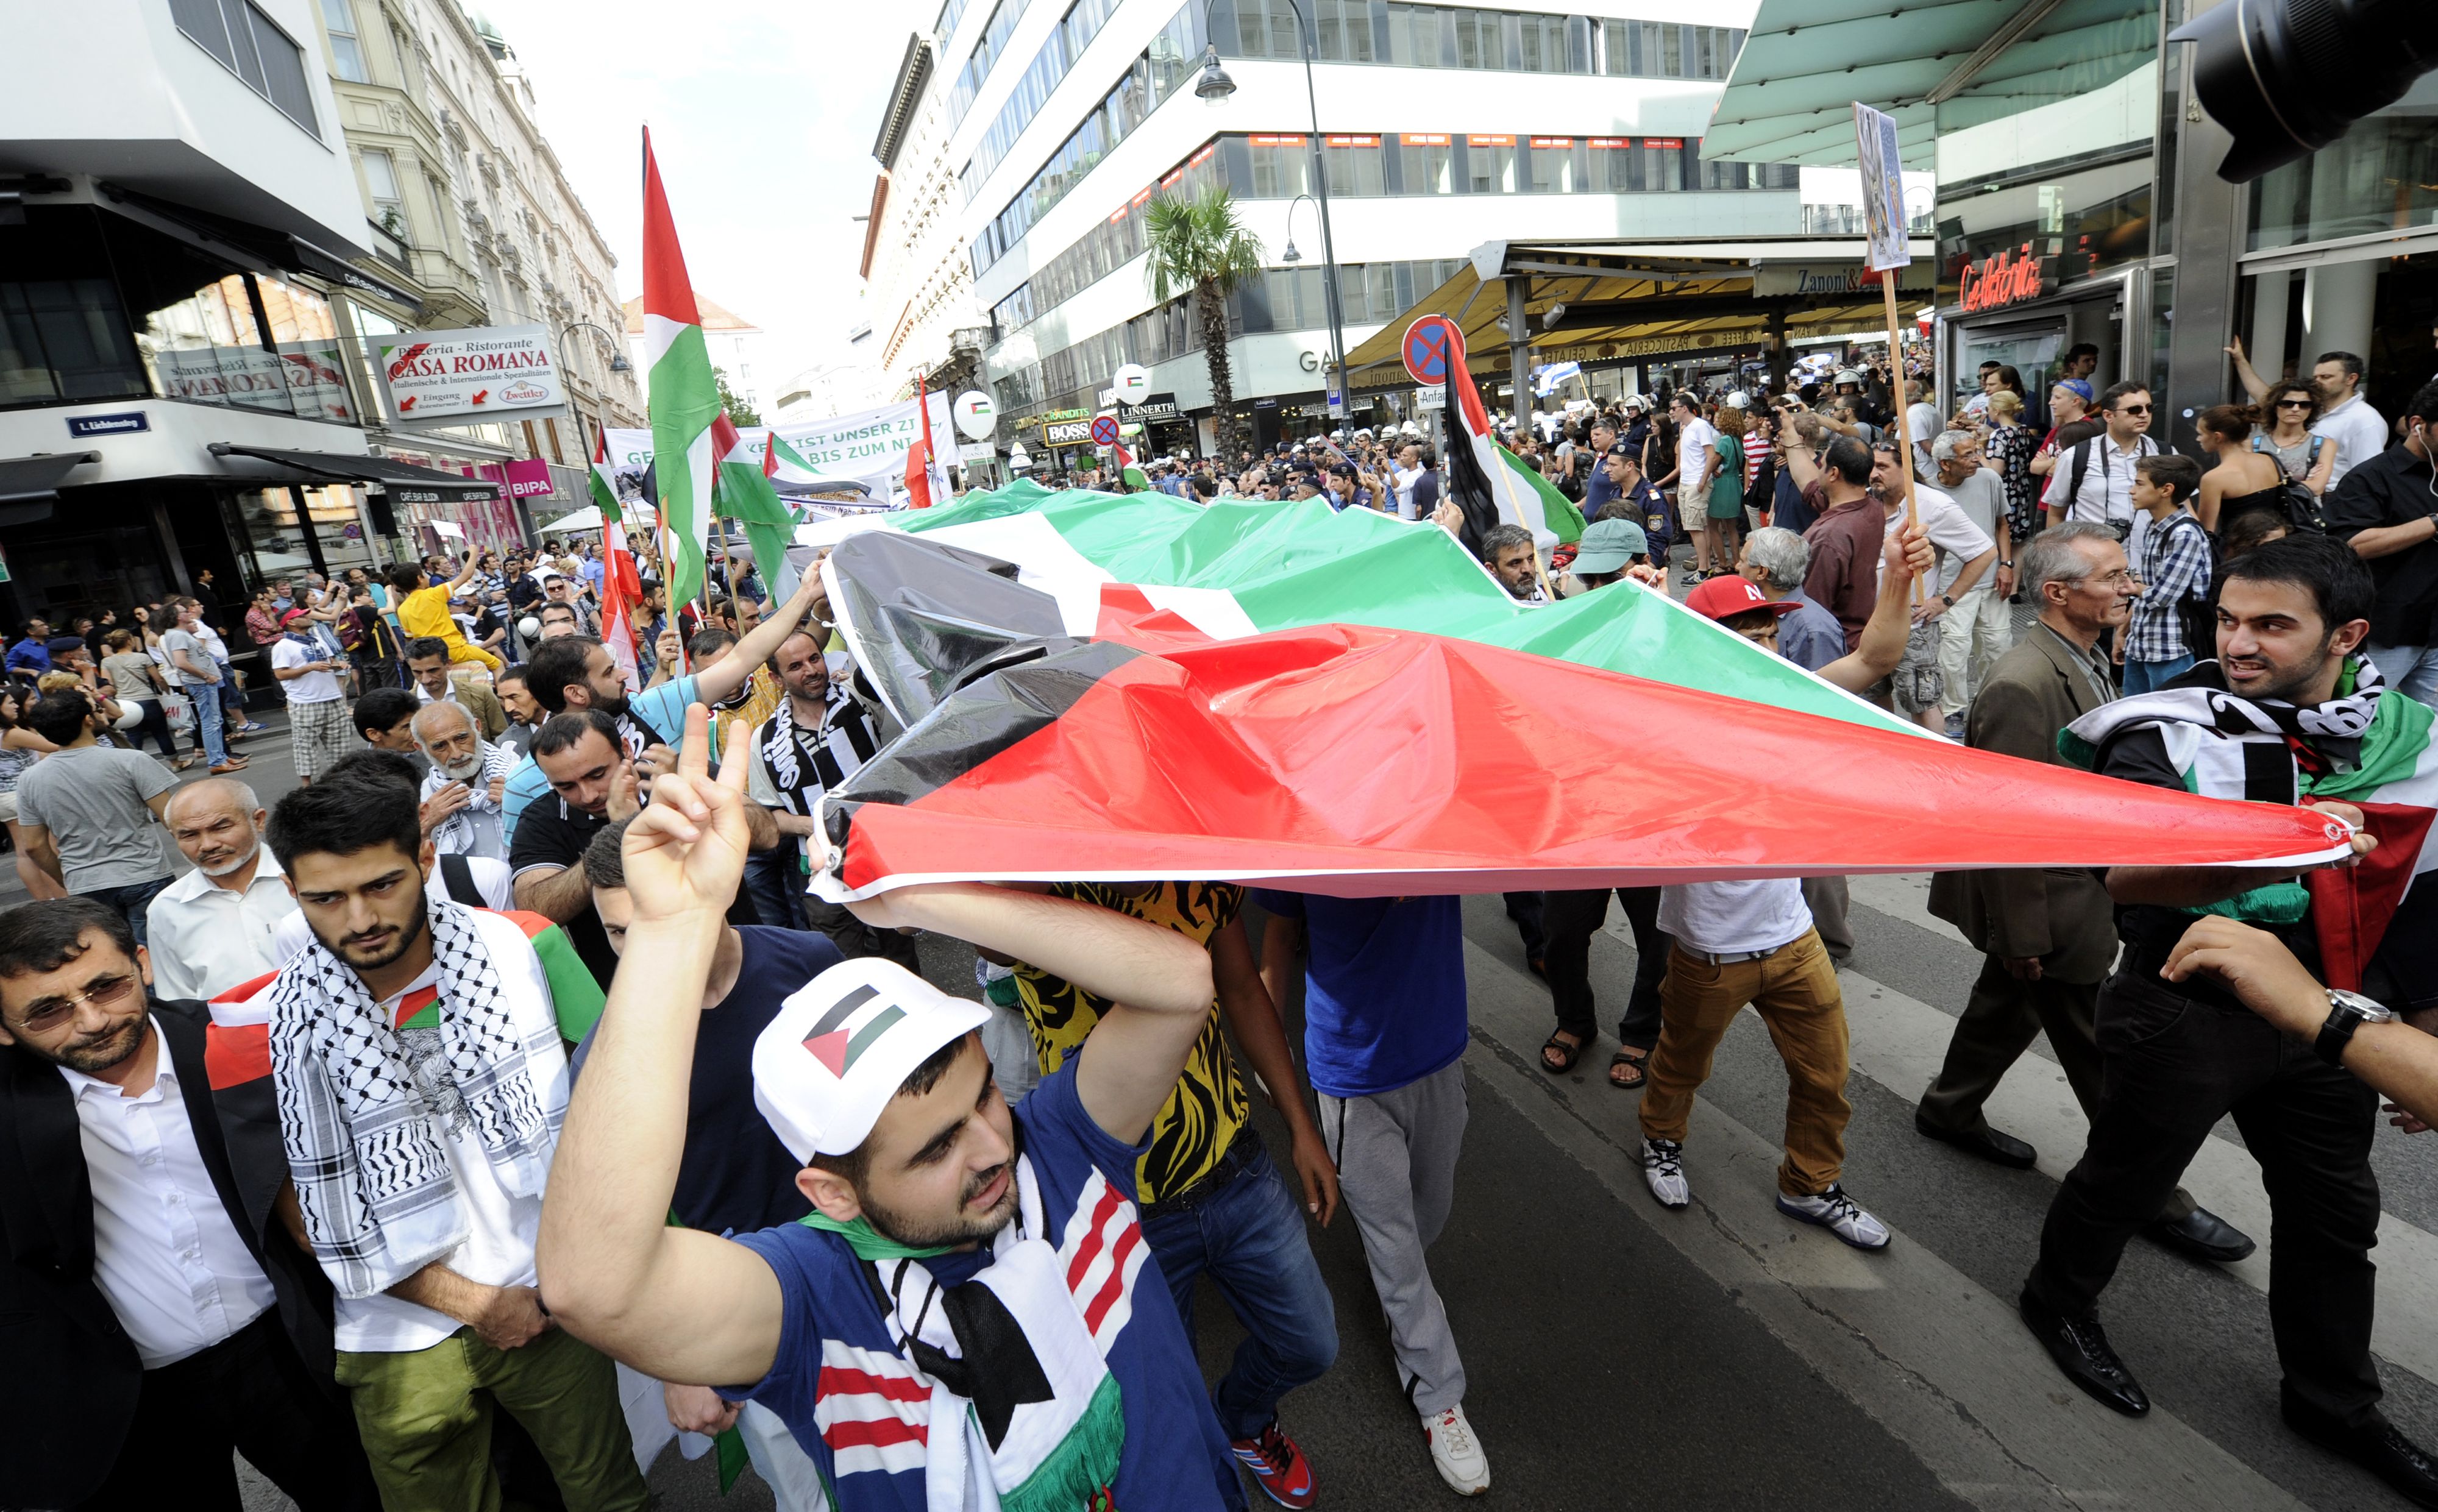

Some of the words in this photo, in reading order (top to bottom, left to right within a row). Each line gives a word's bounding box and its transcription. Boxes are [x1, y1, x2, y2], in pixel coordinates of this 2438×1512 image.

[398, 346, 453, 357] Pizzeria
[466, 338, 533, 352] Ristorante
[390, 357, 447, 380] CASA
[453, 349, 549, 374] ROMANA
[394, 378, 439, 389] Italienische
[450, 372, 502, 383] Internationale
[504, 369, 552, 380] Spezialitäten
[423, 392, 461, 402] Eingang
[505, 389, 544, 400] Zwettler
[1421, 390, 1446, 403] Anfa
[1121, 402, 1176, 417] LINNERTH
[1350, 399, 1373, 410] BIENTE
[795, 435, 826, 448] IST
[834, 423, 892, 442] UNSER
[898, 417, 942, 431] ZIL,
[1048, 423, 1089, 439] BOSS
[809, 450, 841, 465] BIS
[847, 441, 886, 459] ZUM
[512, 480, 550, 495] BIPA
